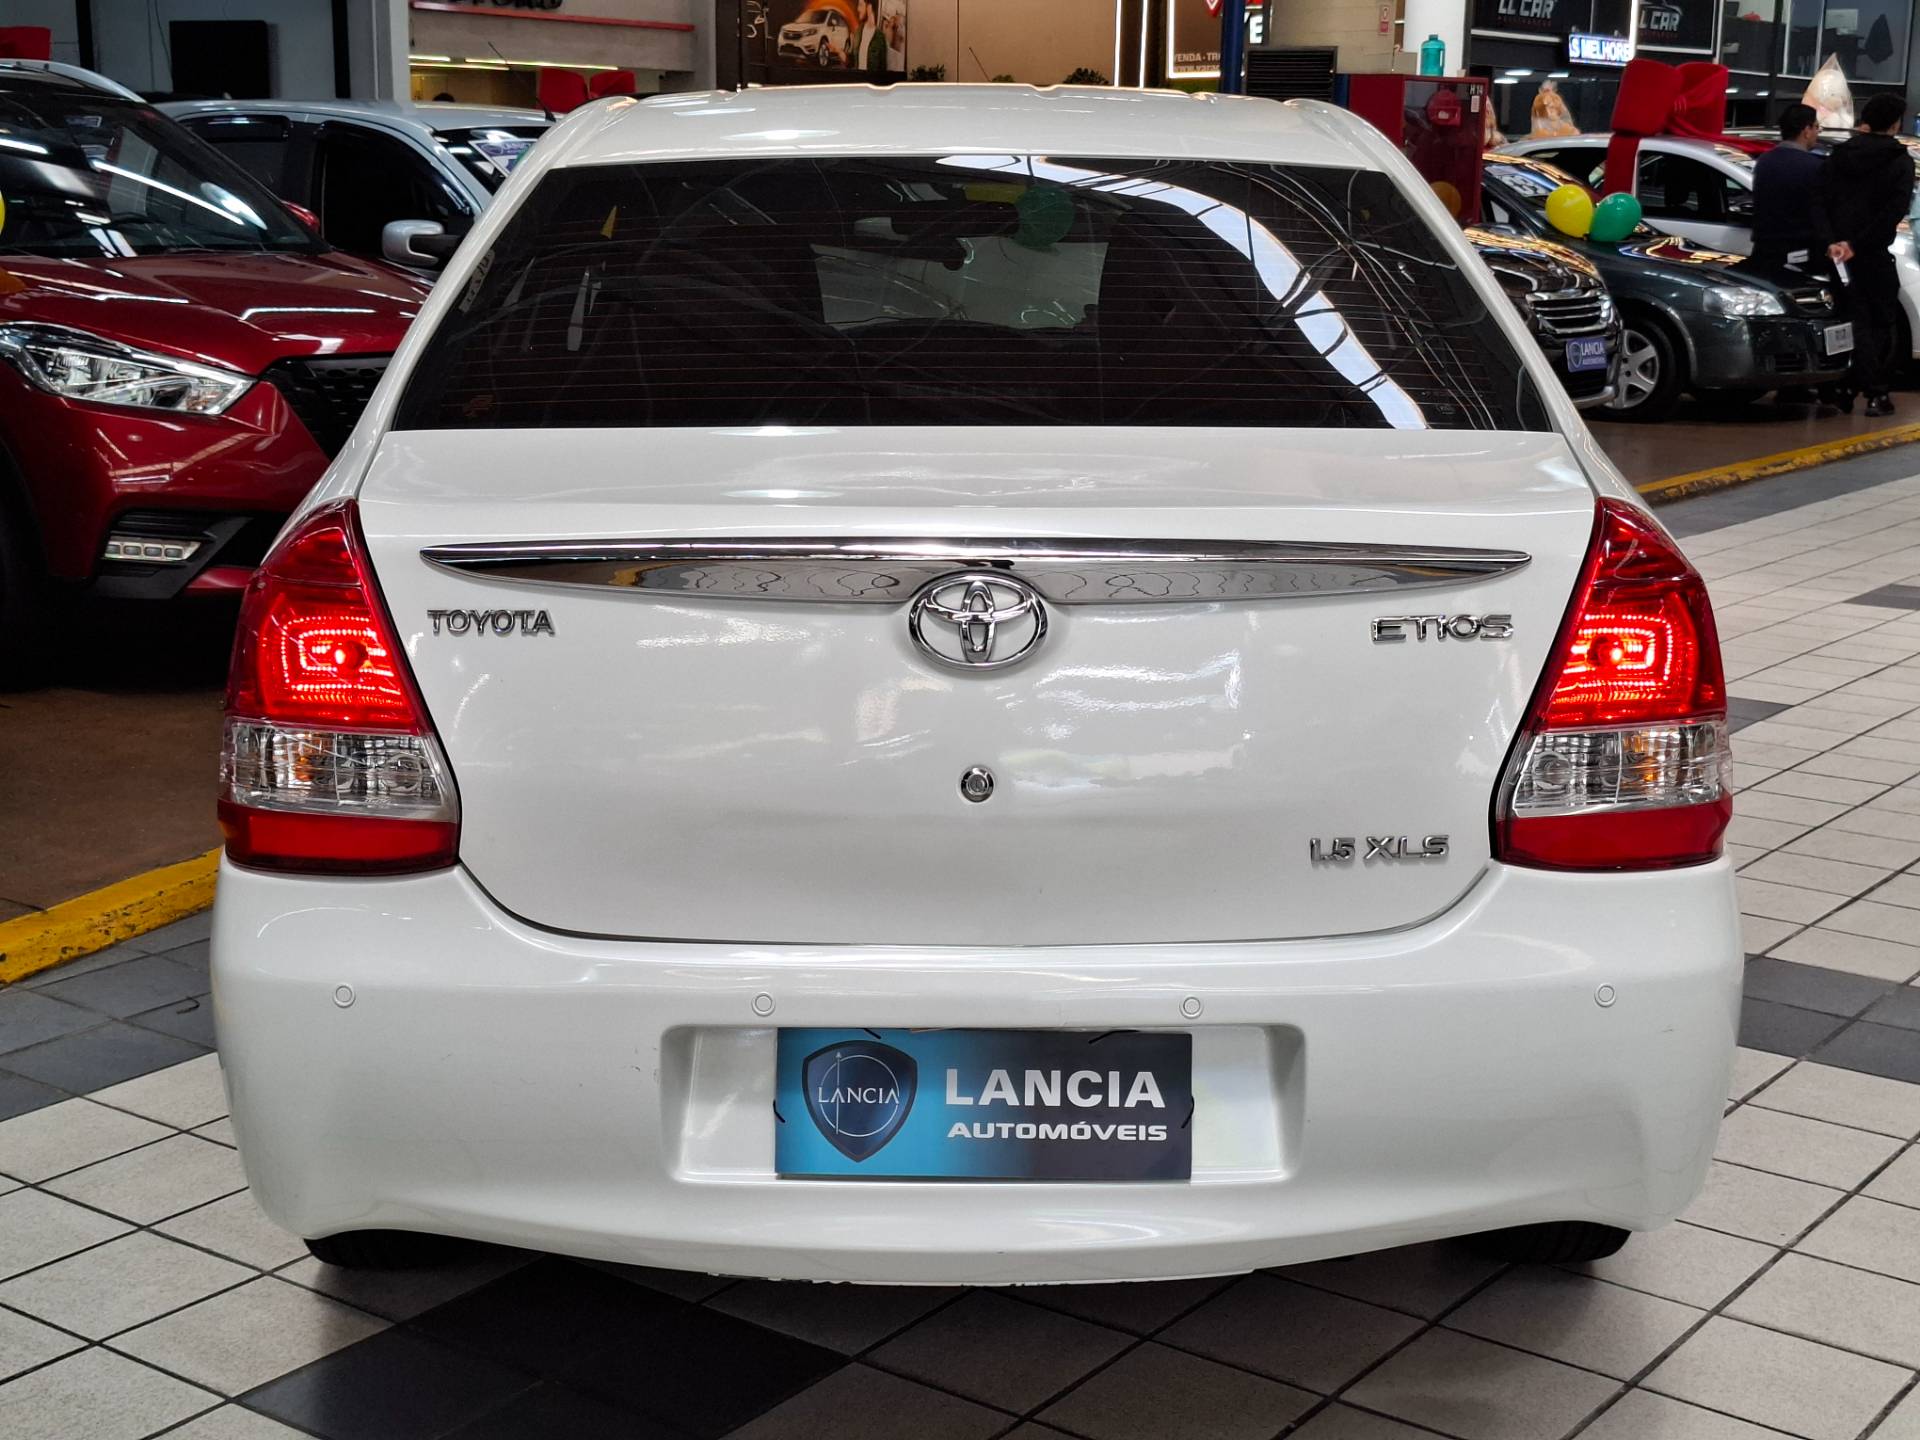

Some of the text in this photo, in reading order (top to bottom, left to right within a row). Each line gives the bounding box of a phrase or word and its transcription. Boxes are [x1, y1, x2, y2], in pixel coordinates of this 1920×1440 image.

[1519, 0, 1554, 19] CAR
[1650, 11, 1680, 32] CAR
[1206, 51, 1221, 61] TR
[1581, 38, 1633, 62] MELHORE
[427, 609, 555, 636] TOYOTA
[1371, 614, 1515, 641] ETIOS
[1310, 835, 1450, 862] 1.5 XLS
[817, 1086, 900, 1104] LANCIA
[945, 1068, 1166, 1109] LANCIA
[947, 1120, 1168, 1141] AUTOMÓVEIS
